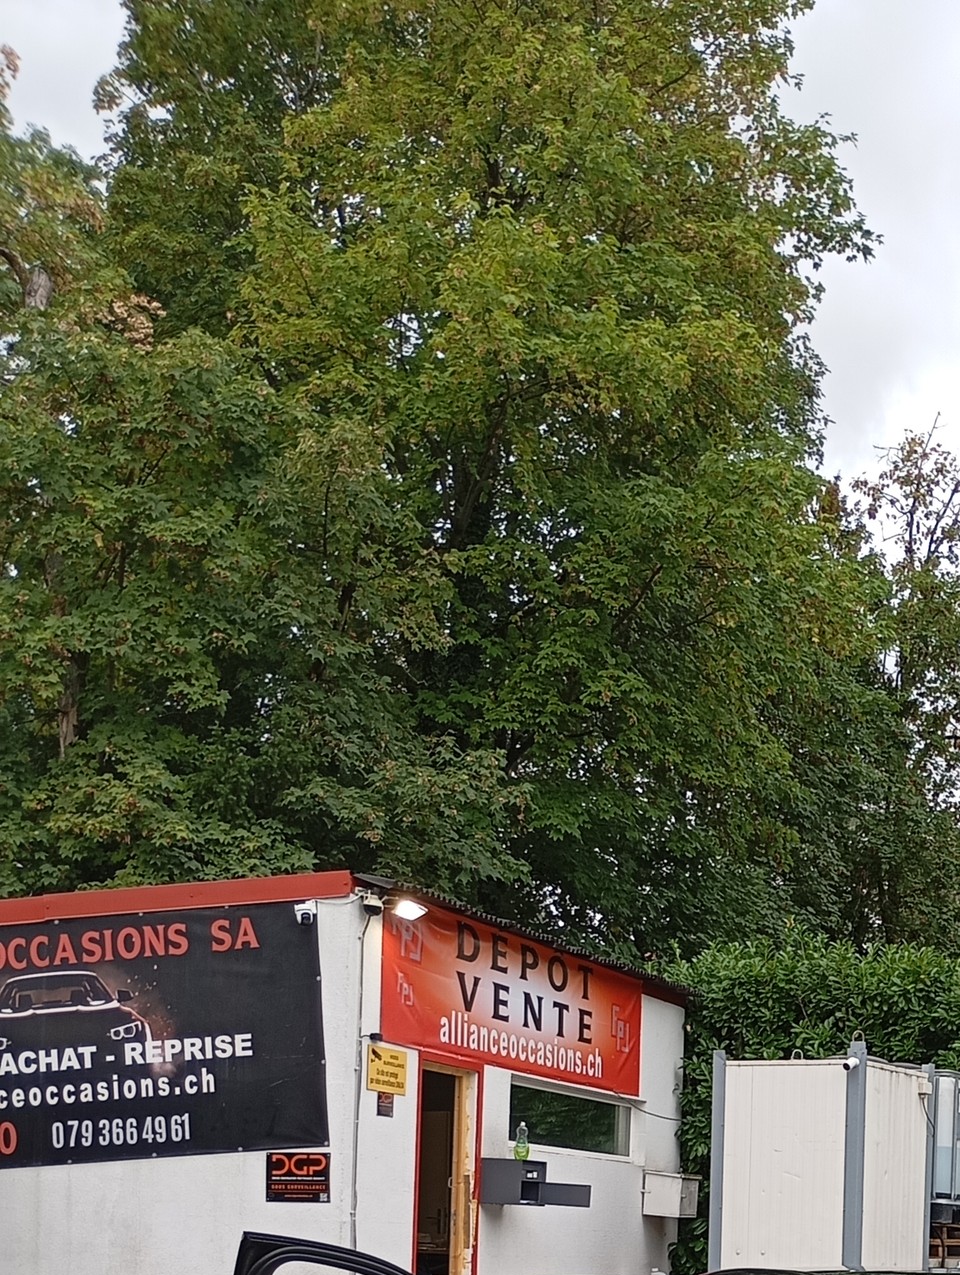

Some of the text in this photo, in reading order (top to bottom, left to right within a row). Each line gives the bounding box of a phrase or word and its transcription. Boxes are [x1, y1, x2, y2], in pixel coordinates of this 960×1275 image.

[0, 917, 260, 970] CCASIONS SA
[456, 970, 593, 1045] VENTE
[0, 1045, 97, 1076] ACHAT
[124, 1033, 253, 1066] REPRISE
[440, 1010, 603, 1078] allianceoccasions.ch
[52, 1119, 93, 1149] 079
[271, 1154, 327, 1175] DGP
